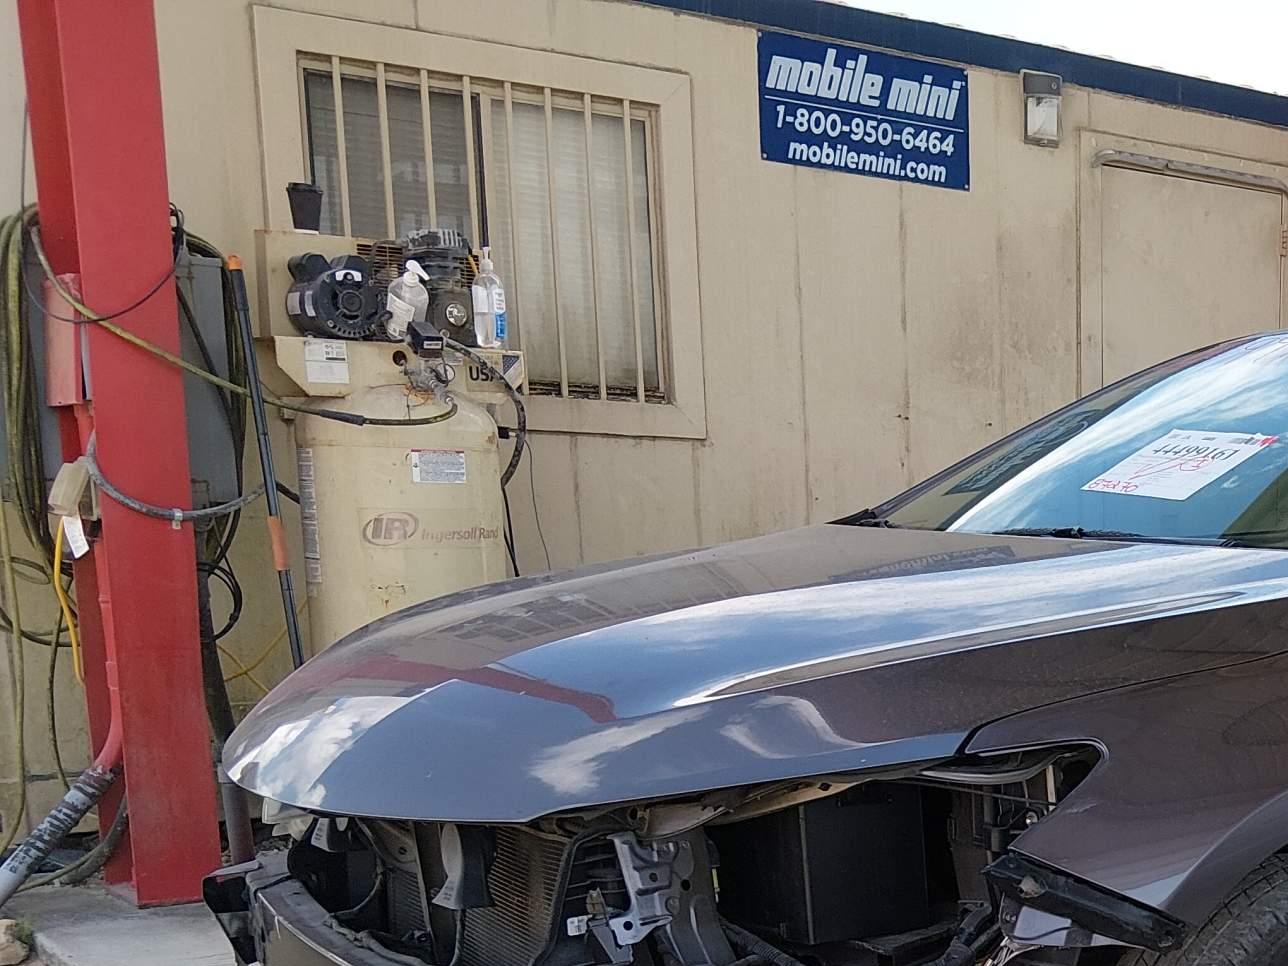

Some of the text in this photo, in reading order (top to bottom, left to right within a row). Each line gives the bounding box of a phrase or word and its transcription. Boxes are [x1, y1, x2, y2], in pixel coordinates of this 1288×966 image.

[766, 48, 961, 121] mobile mini
[776, 105, 955, 156] 1-800-950-6464
[788, 142, 947, 183] mobilemini.com
[479, 526, 499, 540] Rand
